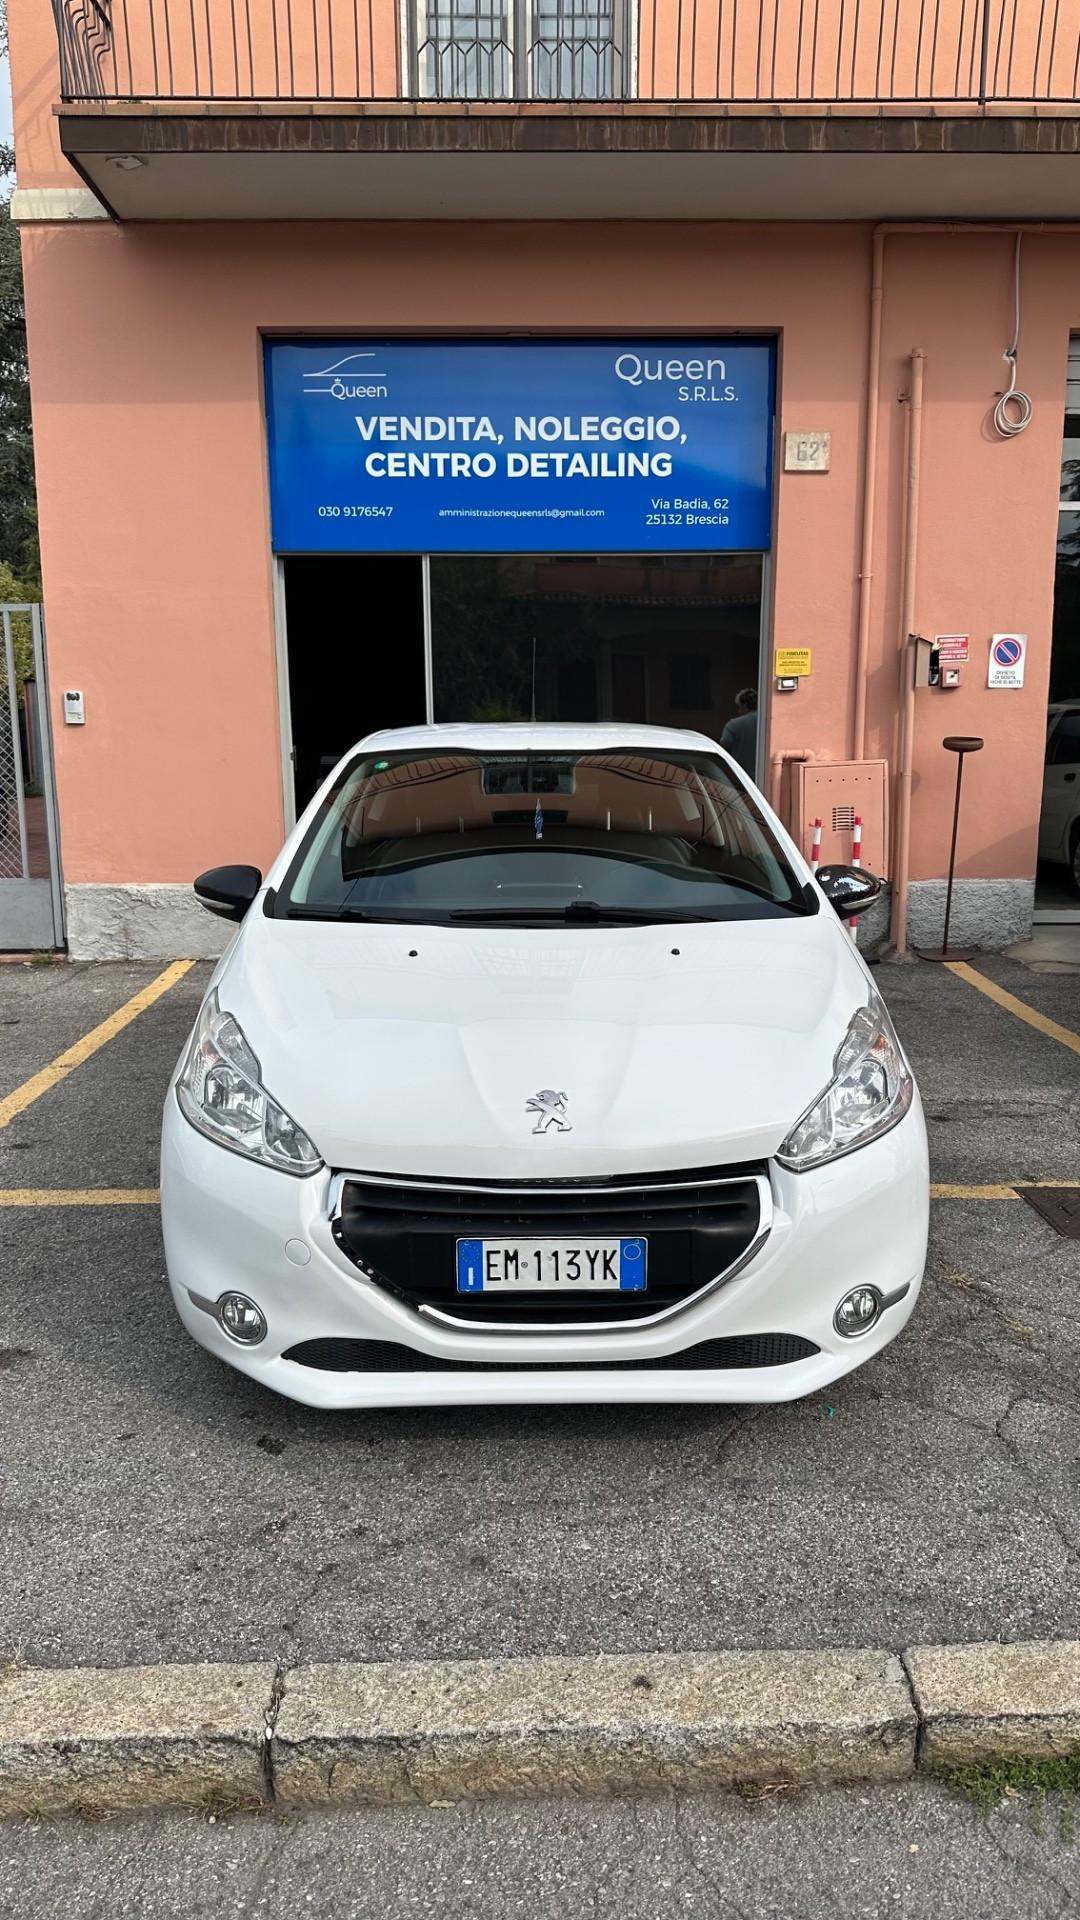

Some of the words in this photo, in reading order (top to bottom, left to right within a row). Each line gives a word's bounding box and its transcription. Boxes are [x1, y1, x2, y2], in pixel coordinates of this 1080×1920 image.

[614, 353, 726, 386] Queen
[330, 383, 388, 400] Queen
[677, 386, 739, 401] S.R.L.S.
[354, 416, 505, 445] VENDITA,
[514, 415, 688, 444] NOLEGGIO,
[365, 452, 497, 478] CENTRO
[506, 452, 673, 478] DETAILING
[318, 506, 341, 517] 030
[343, 506, 393, 518] 9176547
[651, 498, 670, 510] Via
[673, 498, 711, 511] Badia,
[713, 498, 729, 510] 62
[438, 508, 606, 519] amministrazionequeensrls@gmail.com
[645, 514, 683, 525] 25132
[686, 514, 729, 525] Brescia
